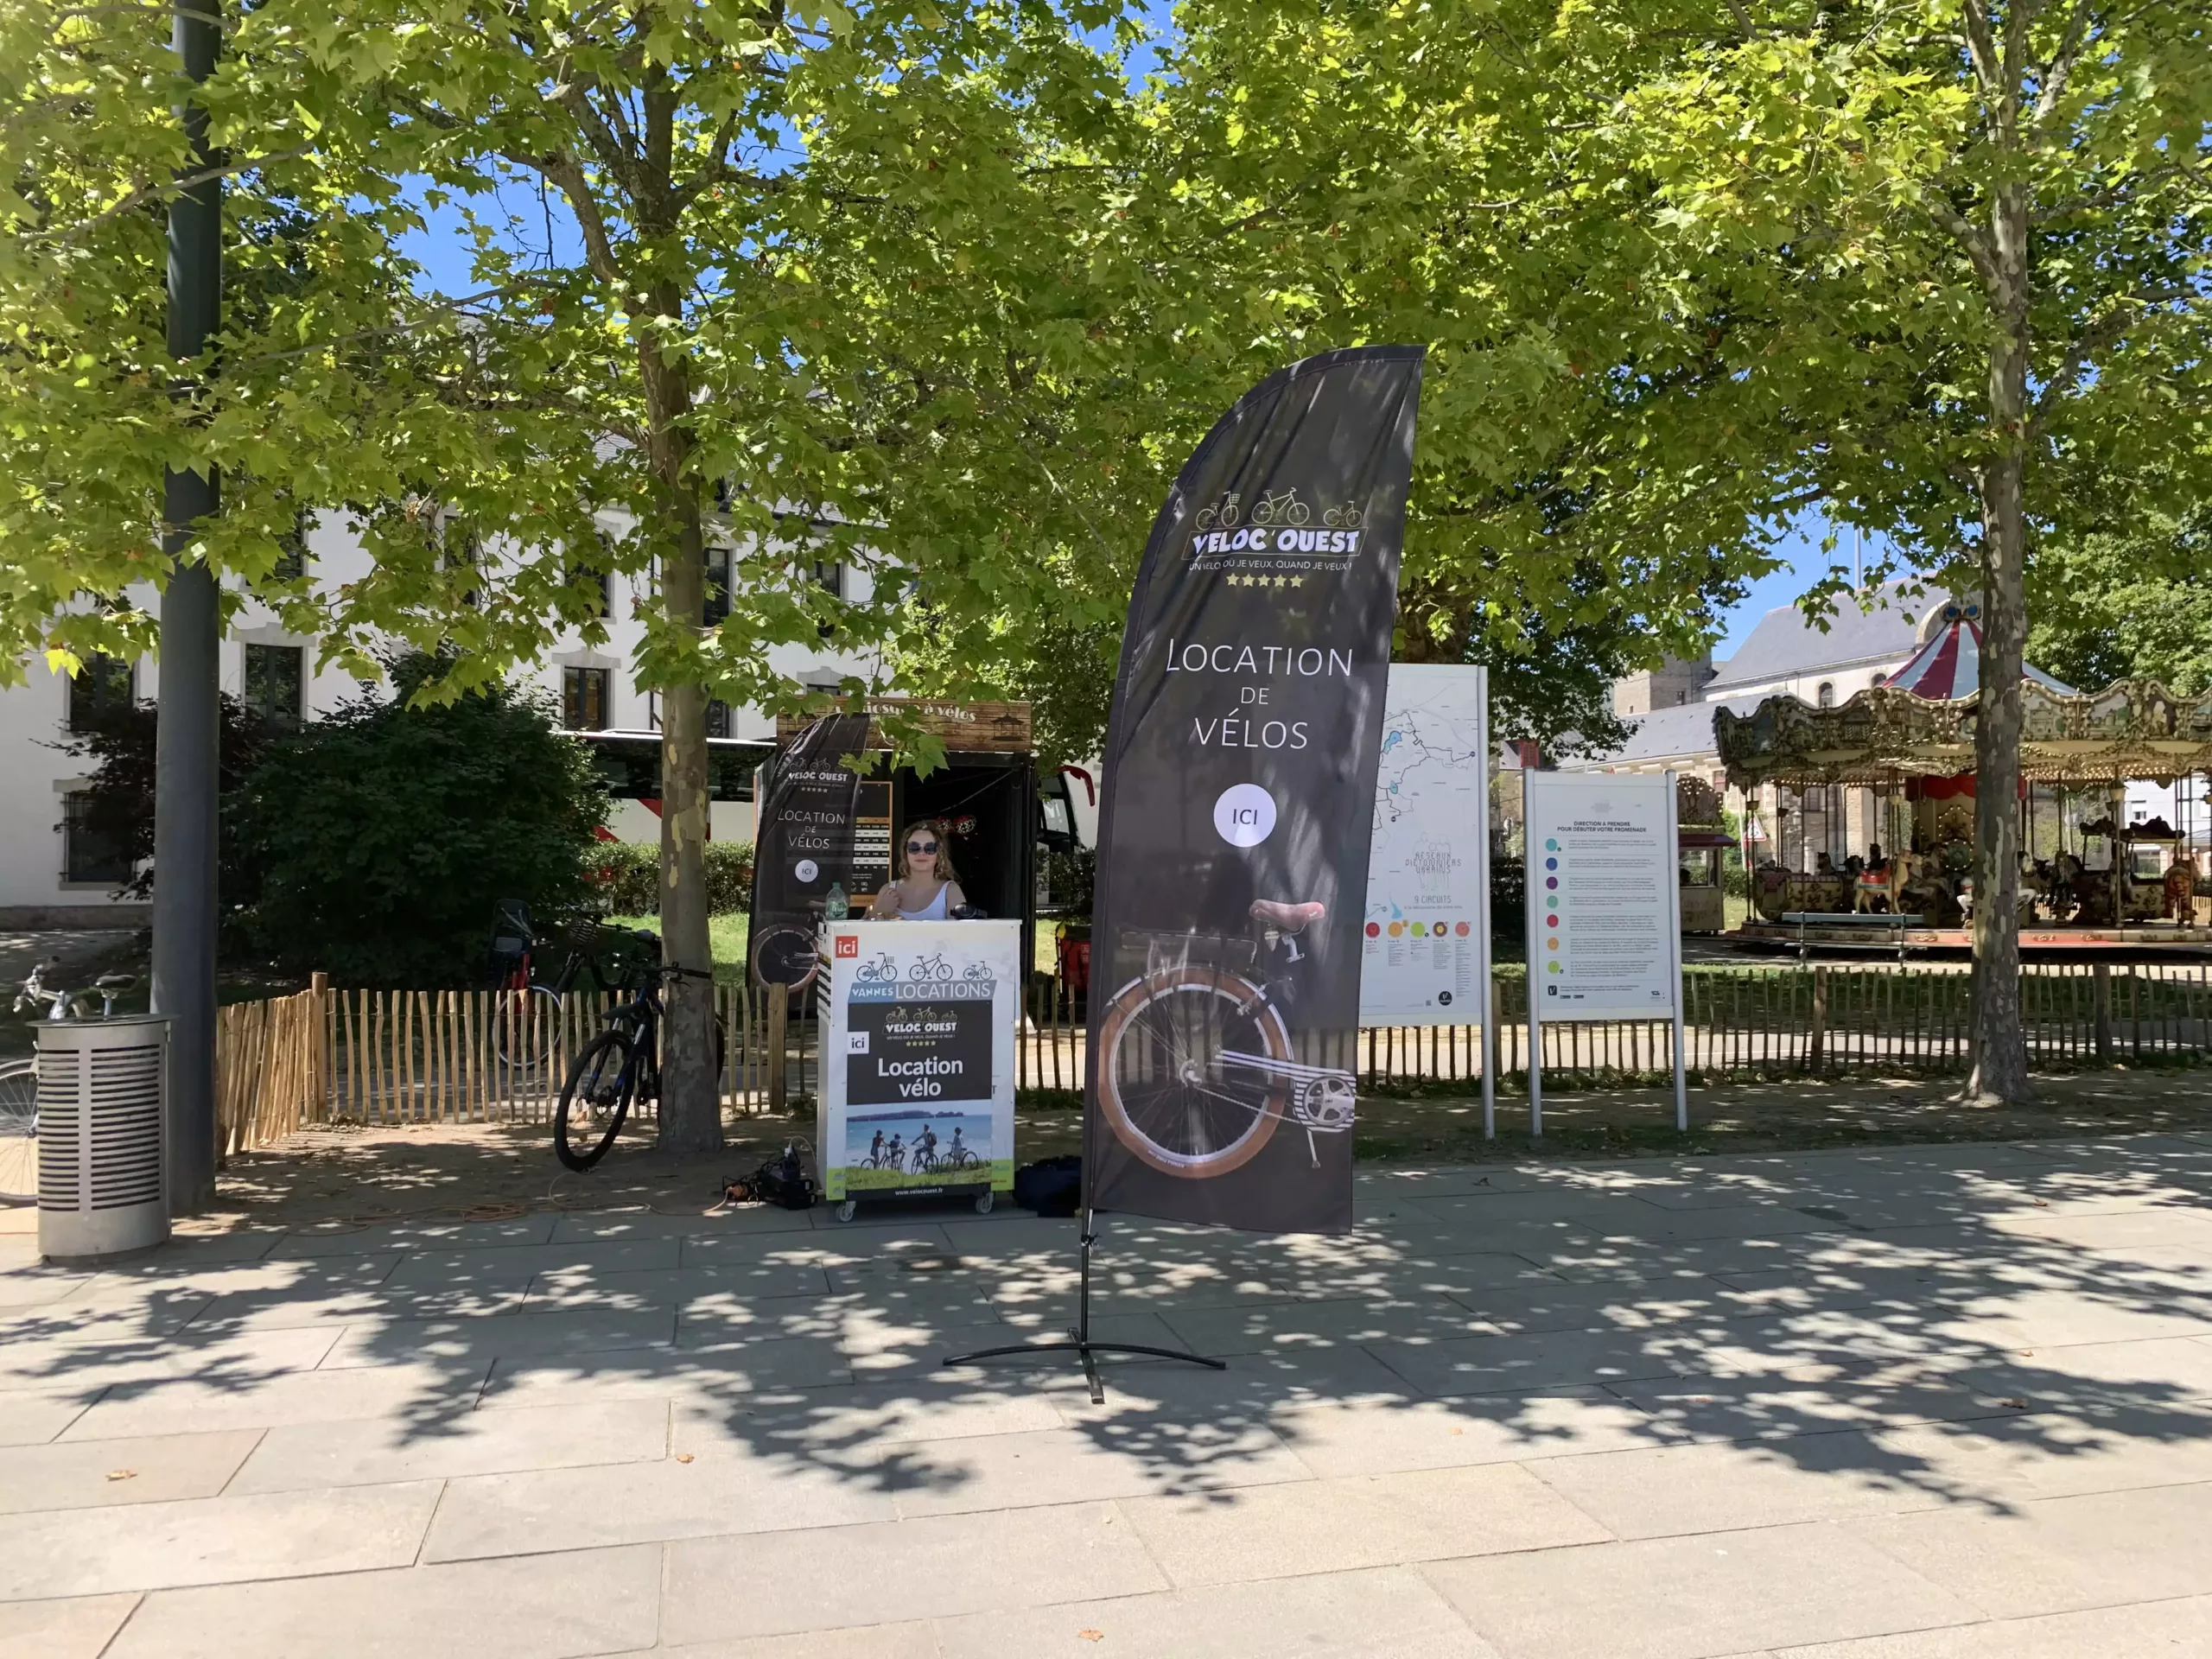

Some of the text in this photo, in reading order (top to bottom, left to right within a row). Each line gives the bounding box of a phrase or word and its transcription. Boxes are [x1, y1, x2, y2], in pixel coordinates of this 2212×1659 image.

[1189, 562, 1202, 571] UN
[1223, 557, 1236, 568] OÙ
[1236, 559, 1247, 568] JE
[1276, 560, 1311, 569] QUAND
[1313, 562, 1323, 570] JE
[1166, 638, 1354, 677] LOCATION
[1241, 687, 1270, 705] DE
[924, 702, 933, 714] à
[937, 705, 977, 722] vélos
[1194, 707, 1309, 750] VÉLOS
[778, 808, 846, 825] LOCATION
[1232, 808, 1258, 826] ICI
[804, 825, 817, 834] DE
[788, 833, 830, 849] VÉLOS
[1421, 895, 1452, 904] CIRCUITS
[837, 941, 857, 954] ici
[852, 982, 991, 1000] VANNES LOCATIONS
[851, 1038, 865, 1049] ici
[878, 1056, 963, 1077] Location
[899, 1077, 942, 1097] vélo
